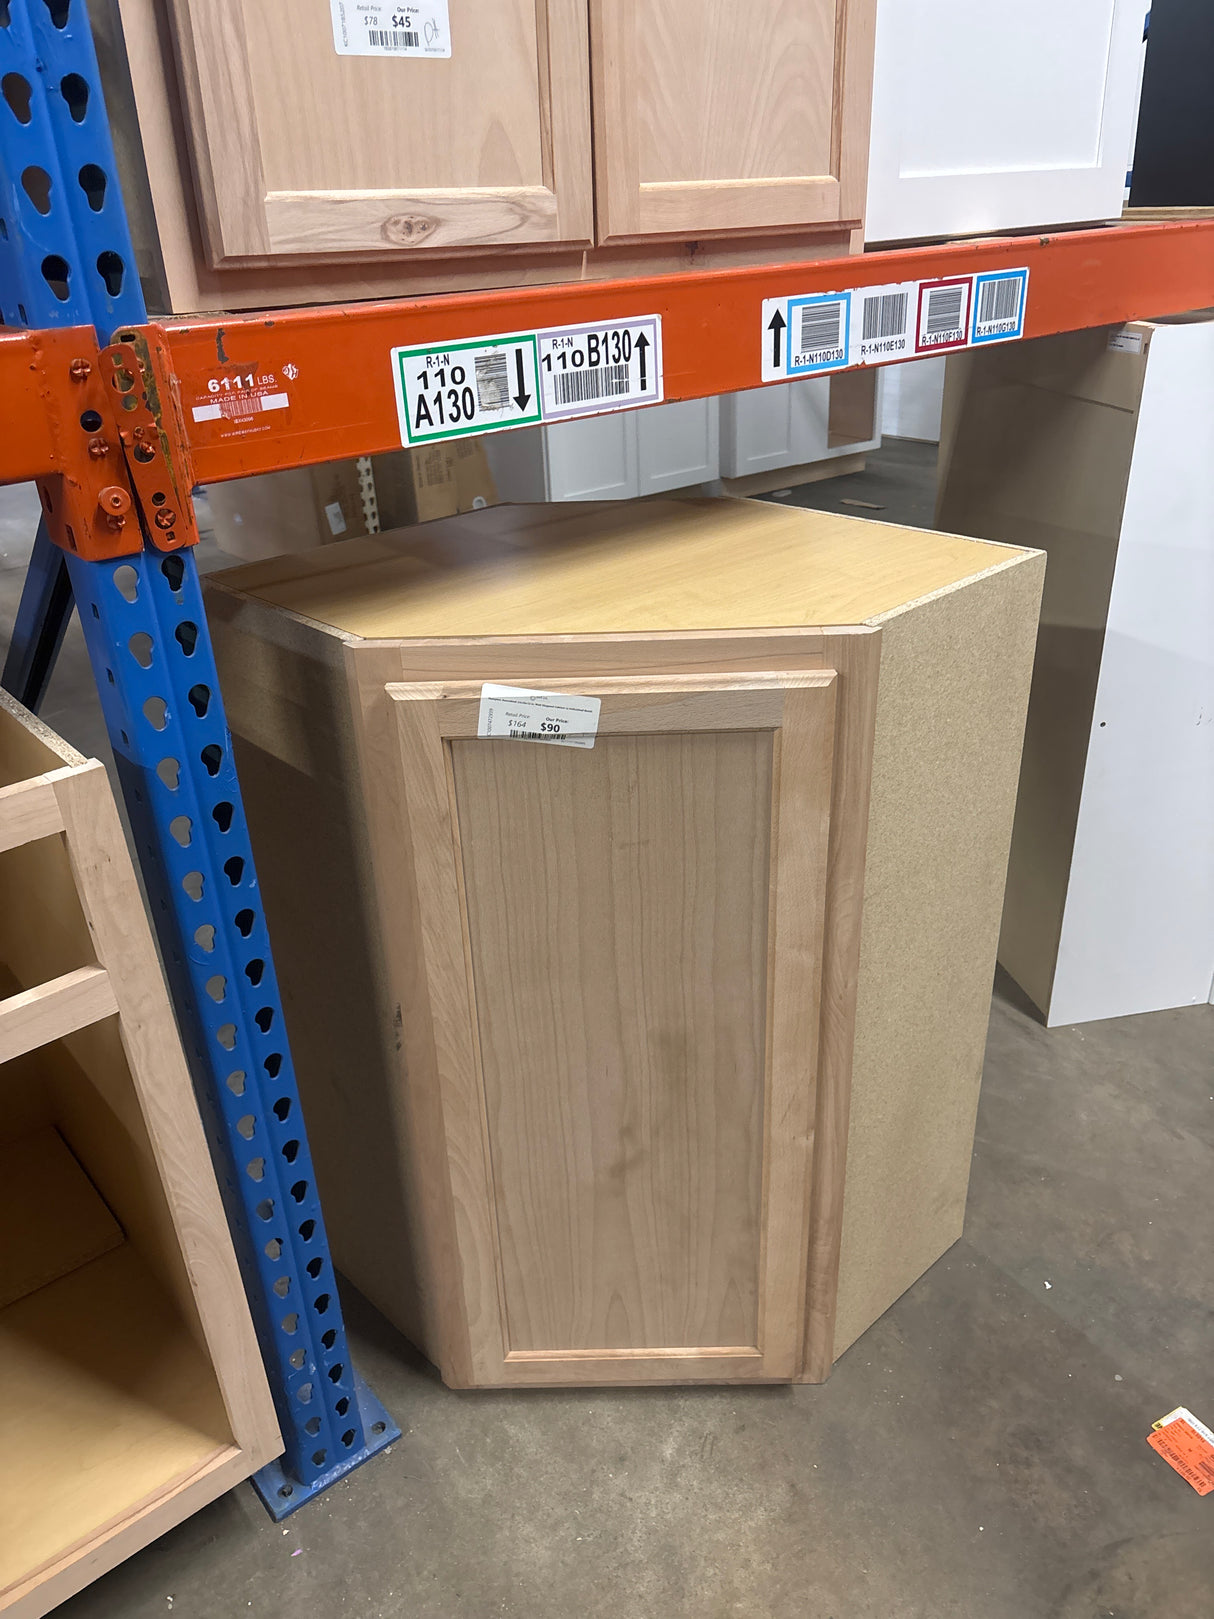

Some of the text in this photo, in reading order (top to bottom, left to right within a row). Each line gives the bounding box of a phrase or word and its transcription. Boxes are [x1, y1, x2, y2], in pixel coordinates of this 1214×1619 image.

[356, 4, 370, 12] Retail
[364, 15, 378, 26] $78
[391, 14, 411, 28] $45
[976, 321, 1016, 337] R-1-N110G130
[552, 336, 574, 351] R-1-N
[921, 330, 963, 346] R-1-N110F130
[587, 329, 632, 368] B130
[860, 339, 906, 356] R-1-N110E130
[426, 353, 450, 369] R-1-N
[541, 349, 584, 372] 110
[794, 348, 844, 367] R-1-N110D130
[207, 374, 254, 392] 6111
[416, 365, 466, 390] 110
[210, 395, 237, 404] MADE
[250, 390, 269, 398] USA
[414, 386, 476, 429] A130
[507, 719, 527, 728] $164
[540, 722, 561, 733] $90
